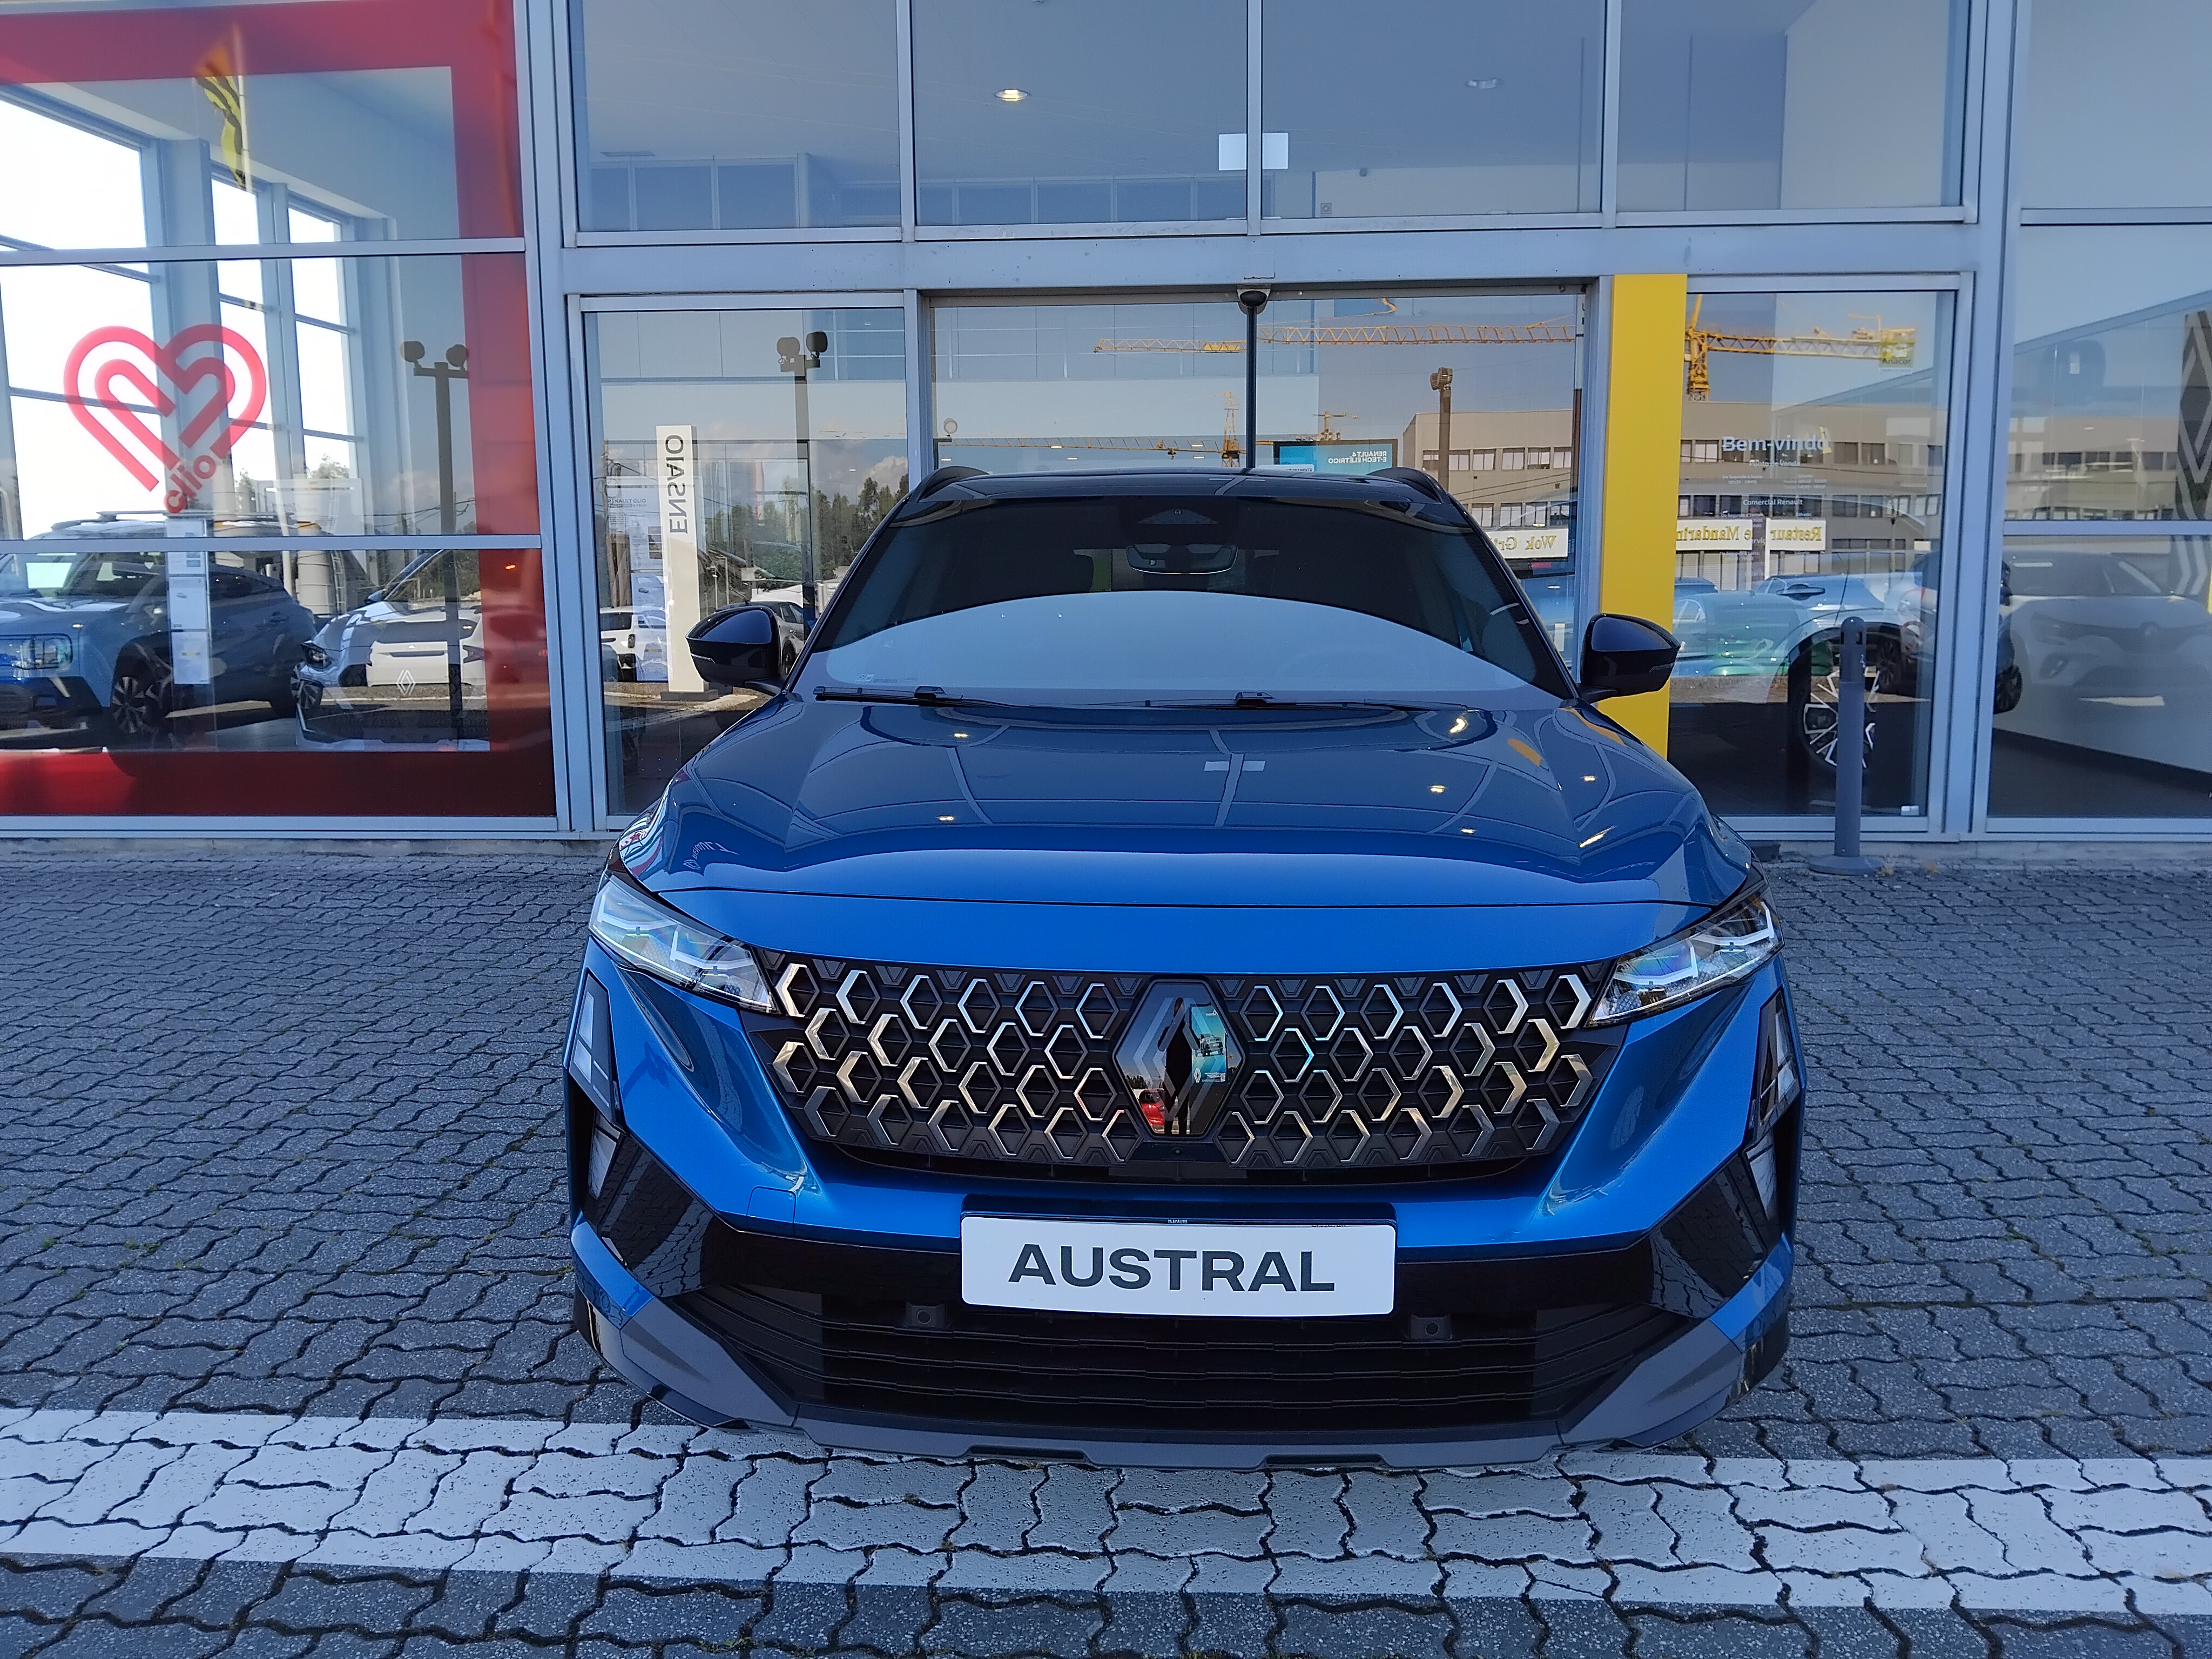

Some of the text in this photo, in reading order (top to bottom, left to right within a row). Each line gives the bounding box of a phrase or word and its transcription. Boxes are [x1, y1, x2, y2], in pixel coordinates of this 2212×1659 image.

[1722, 434, 1829, 451] Bem-vindo
[163, 455, 216, 514] clio
[1008, 1243, 1336, 1292] AUSTRAL
